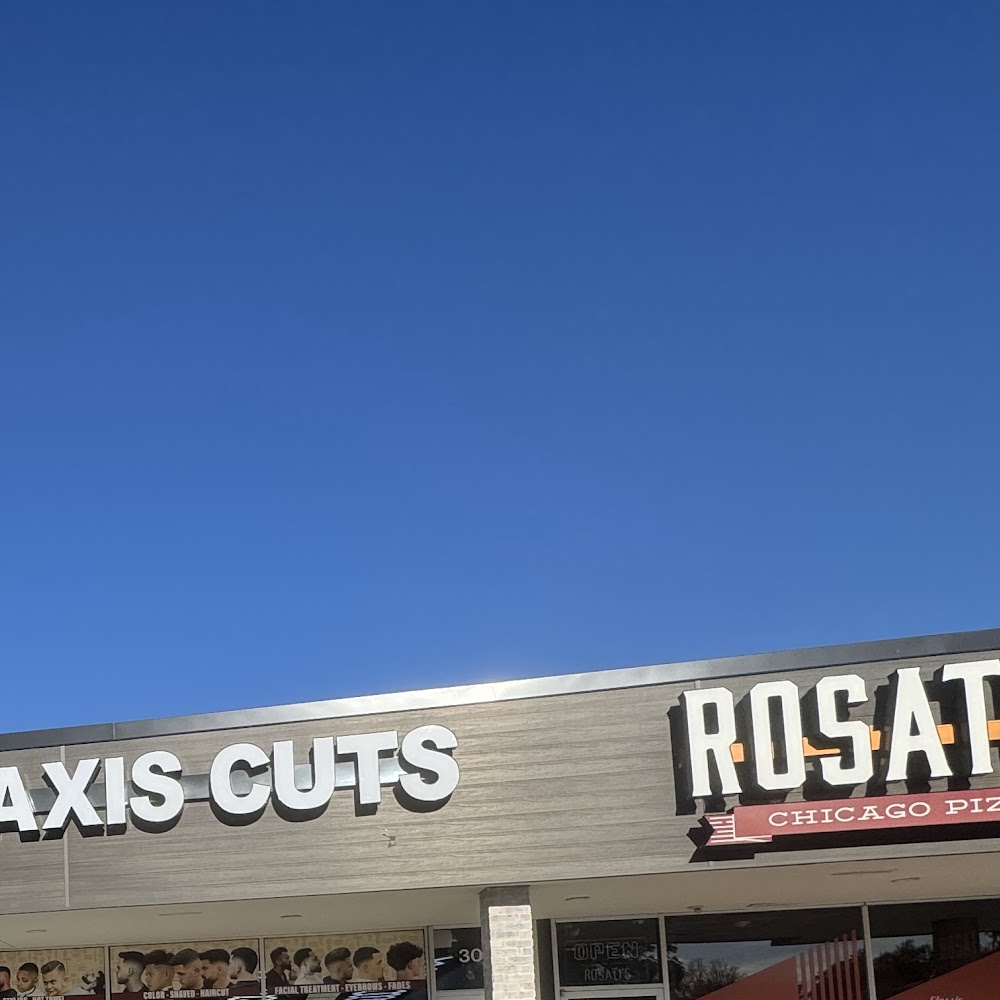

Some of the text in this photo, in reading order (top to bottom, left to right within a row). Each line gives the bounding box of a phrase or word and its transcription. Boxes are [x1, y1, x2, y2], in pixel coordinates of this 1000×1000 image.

[683, 659, 1000, 797] ROSAT
[210, 725, 461, 815] CUTS
[768, 802, 931, 828] CHICAGO
[458, 948, 483, 963] 30
[574, 941, 639, 960] OPEN
[143, 990, 165, 999] COLOR
[170, 989, 195, 998] SHAVED
[200, 988, 230, 997] HAIRCUT
[275, 986, 298, 994] FACIAL
[300, 983, 339, 993] TREATMENT
[345, 982, 382, 991] EYEBROWS
[388, 981, 411, 990] FADES
